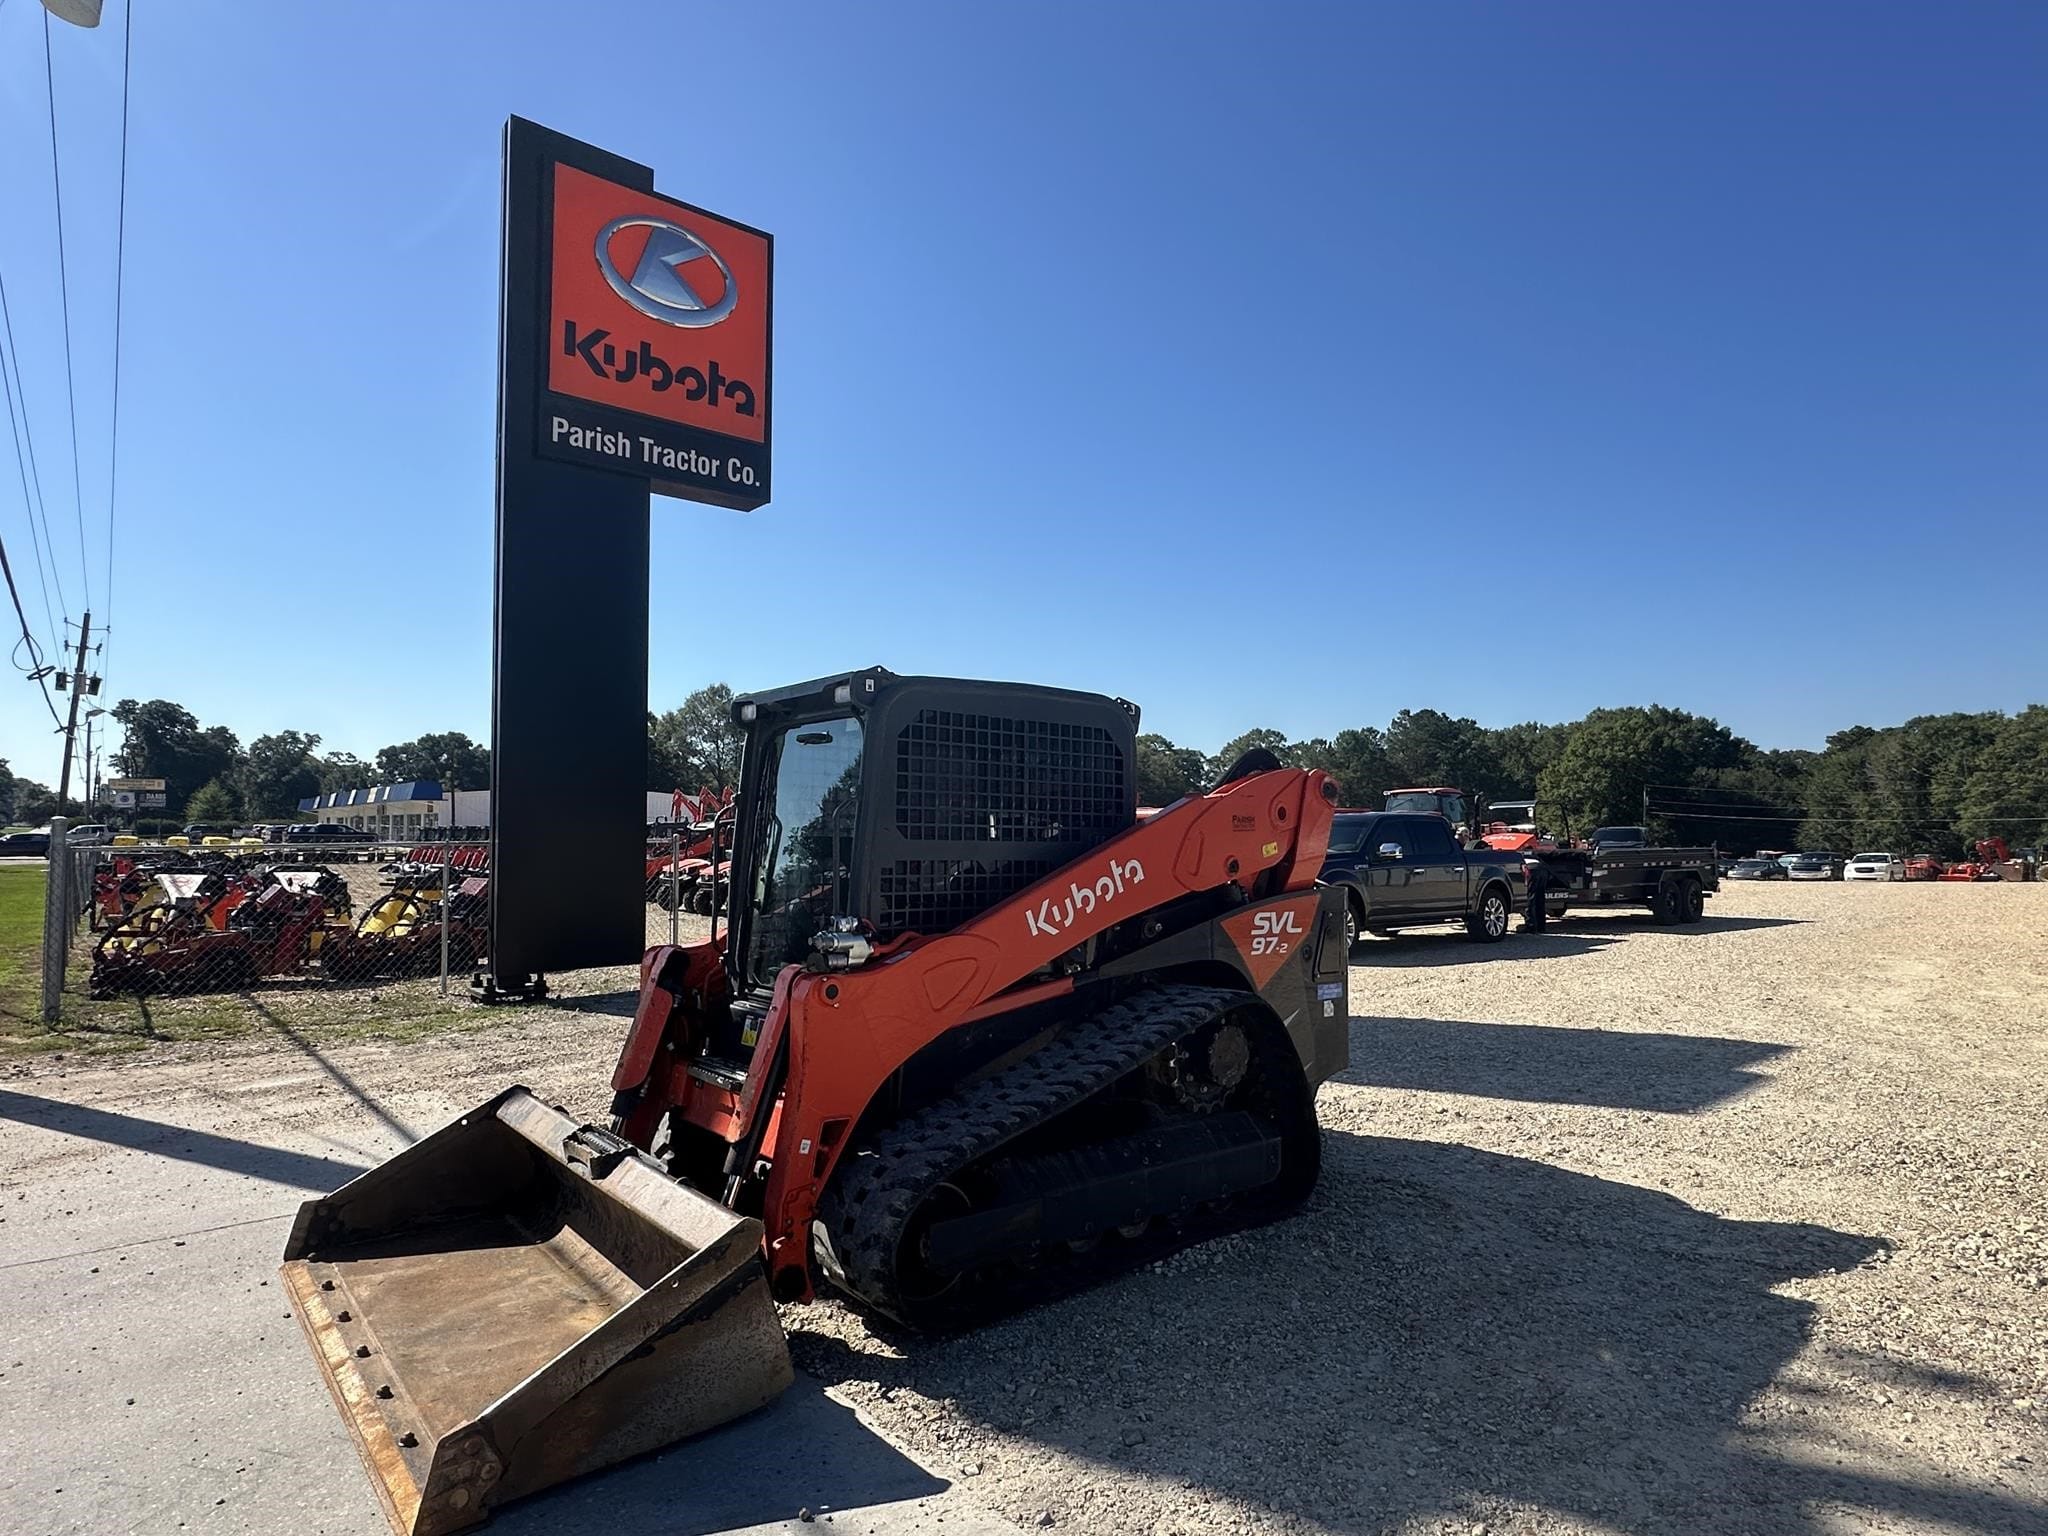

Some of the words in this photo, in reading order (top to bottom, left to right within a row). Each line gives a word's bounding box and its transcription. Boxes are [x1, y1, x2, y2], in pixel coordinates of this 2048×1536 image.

[564, 320, 755, 417] Kubota
[552, 416, 631, 458] Parish
[639, 436, 720, 478] Tractor
[727, 457, 761, 487] Co.
[1025, 859, 1145, 937] Kubota
[1251, 911, 1303, 935] SVL
